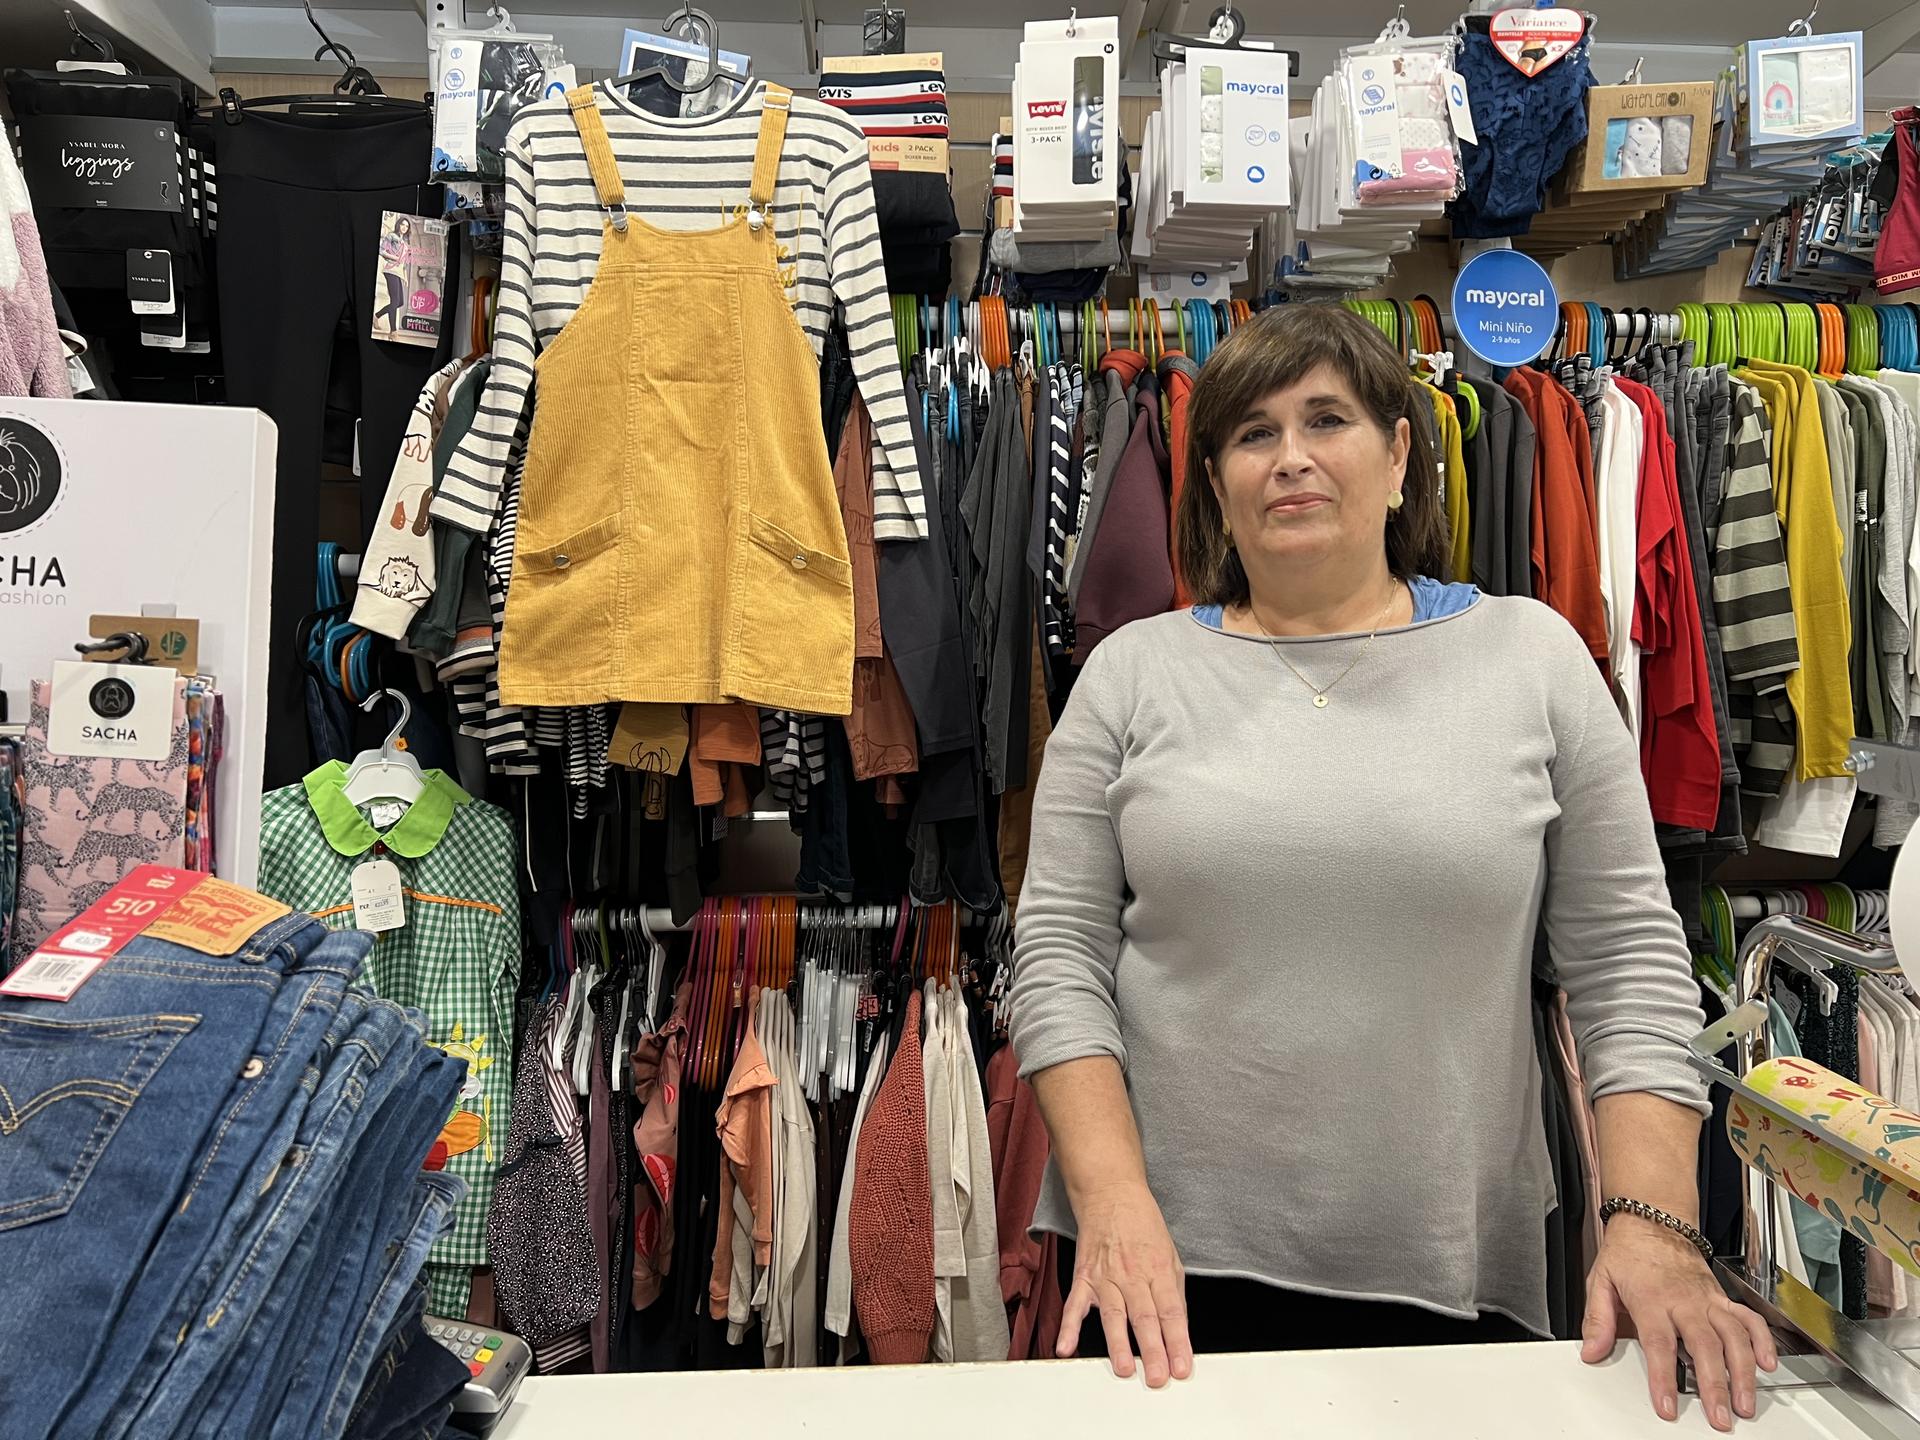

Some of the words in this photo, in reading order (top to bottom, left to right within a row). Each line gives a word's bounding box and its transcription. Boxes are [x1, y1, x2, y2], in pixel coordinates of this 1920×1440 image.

[1511, 16, 1567, 27] Variance
[818, 88, 852, 99] evi's
[1226, 82, 1284, 95] mayoral
[439, 89, 476, 101] mayoral
[1031, 135, 1062, 144] 3-PACK
[101, 142, 126, 150] MORA
[61, 148, 135, 178] leggings
[1825, 202, 1846, 241] DIM
[1466, 288, 1545, 309] mayoral
[411, 301, 425, 310] UP
[406, 322, 435, 333] PITILLO
[1479, 320, 1503, 332] Mini
[1506, 321, 1533, 334] Niño
[1491, 335, 1503, 343] 2-9
[1504, 336, 1521, 344] años
[0, 589, 66, 606] ashion
[81, 726, 137, 740] SACHA
[104, 897, 157, 917] 510
